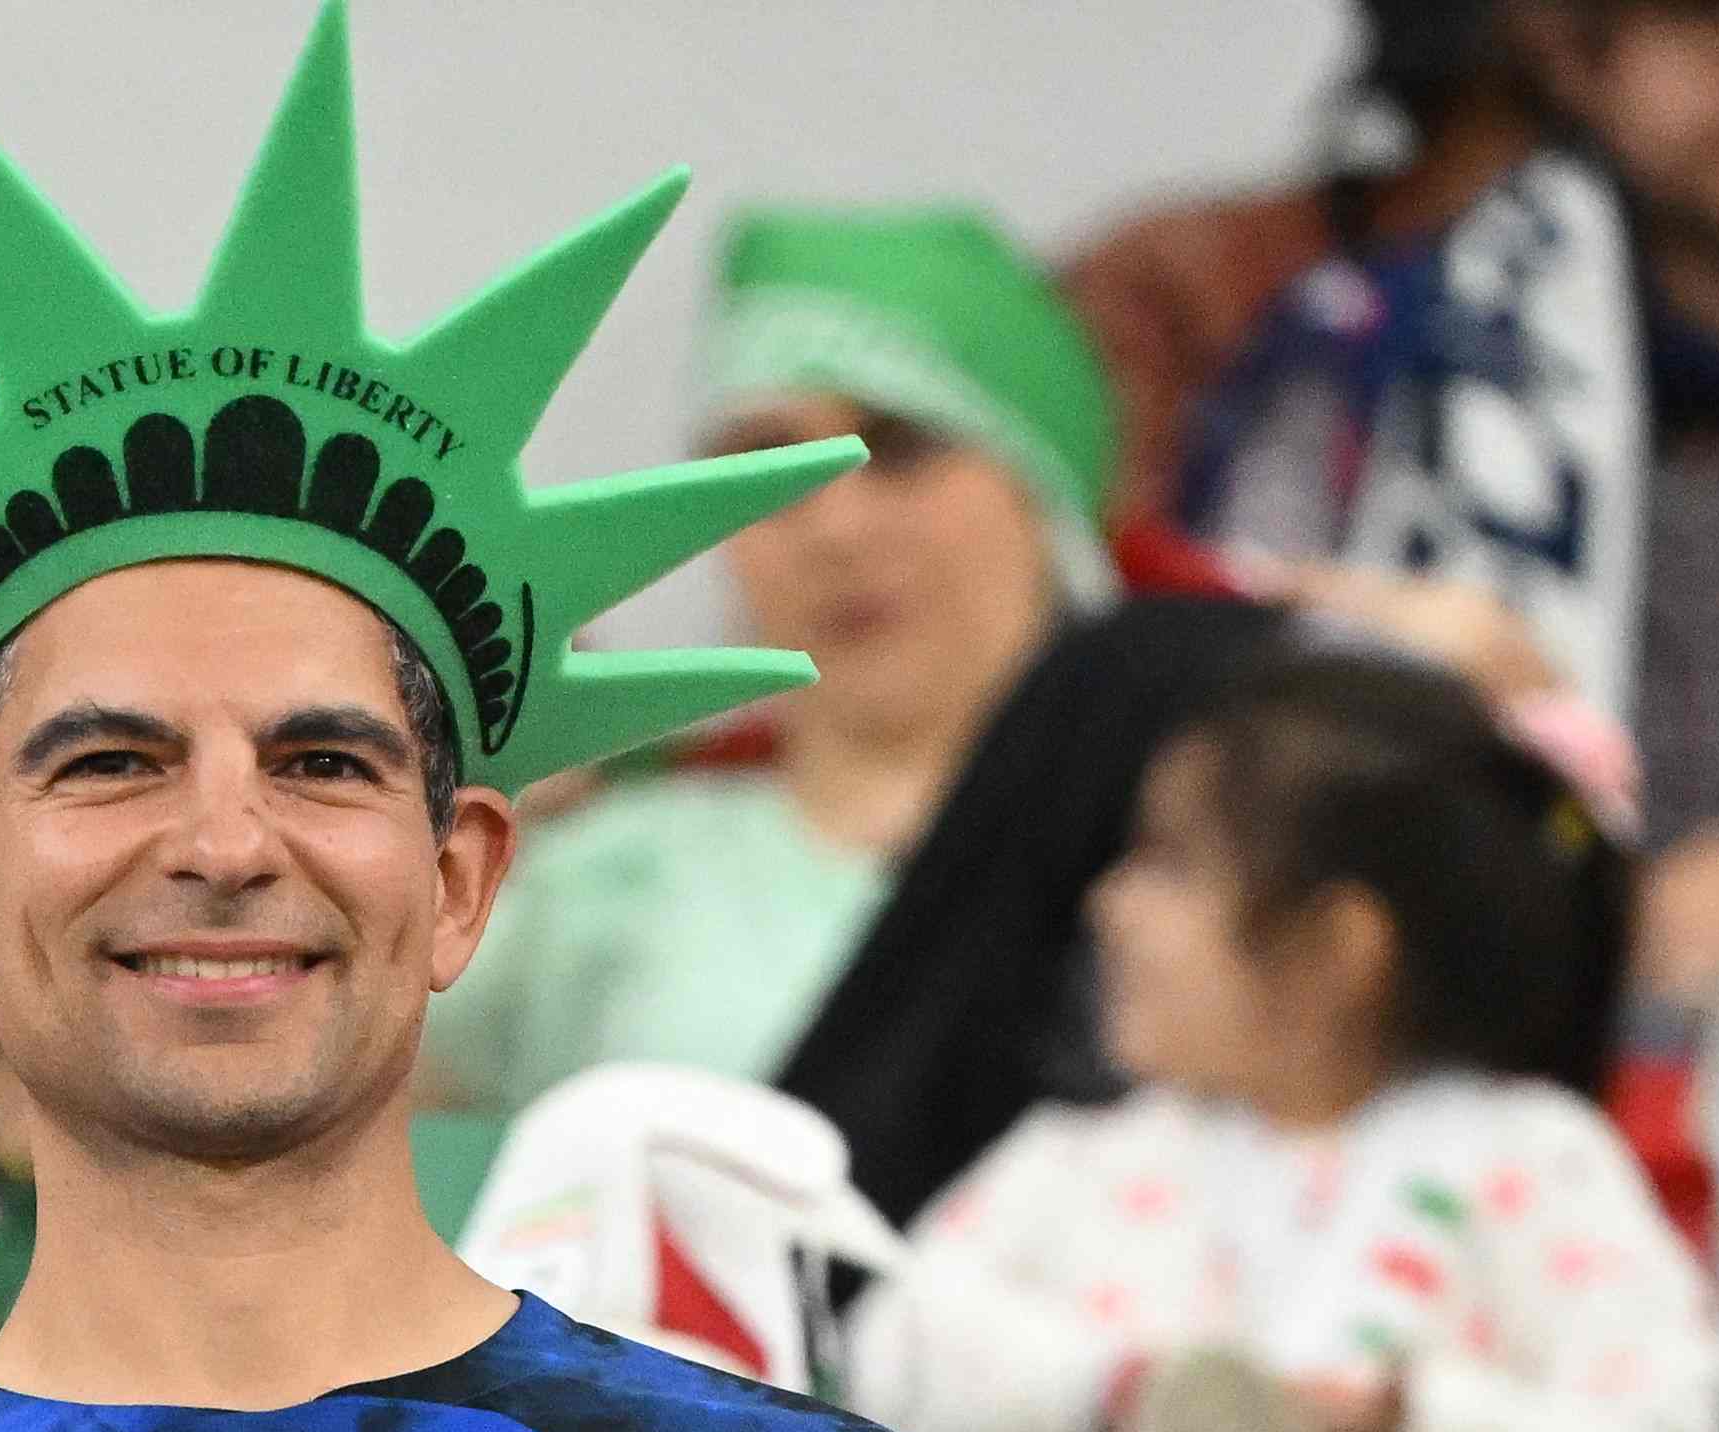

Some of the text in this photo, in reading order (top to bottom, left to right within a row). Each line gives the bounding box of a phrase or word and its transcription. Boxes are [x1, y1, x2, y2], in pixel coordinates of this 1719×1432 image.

[22, 345, 465, 461] STATUE OF LIBERTY
